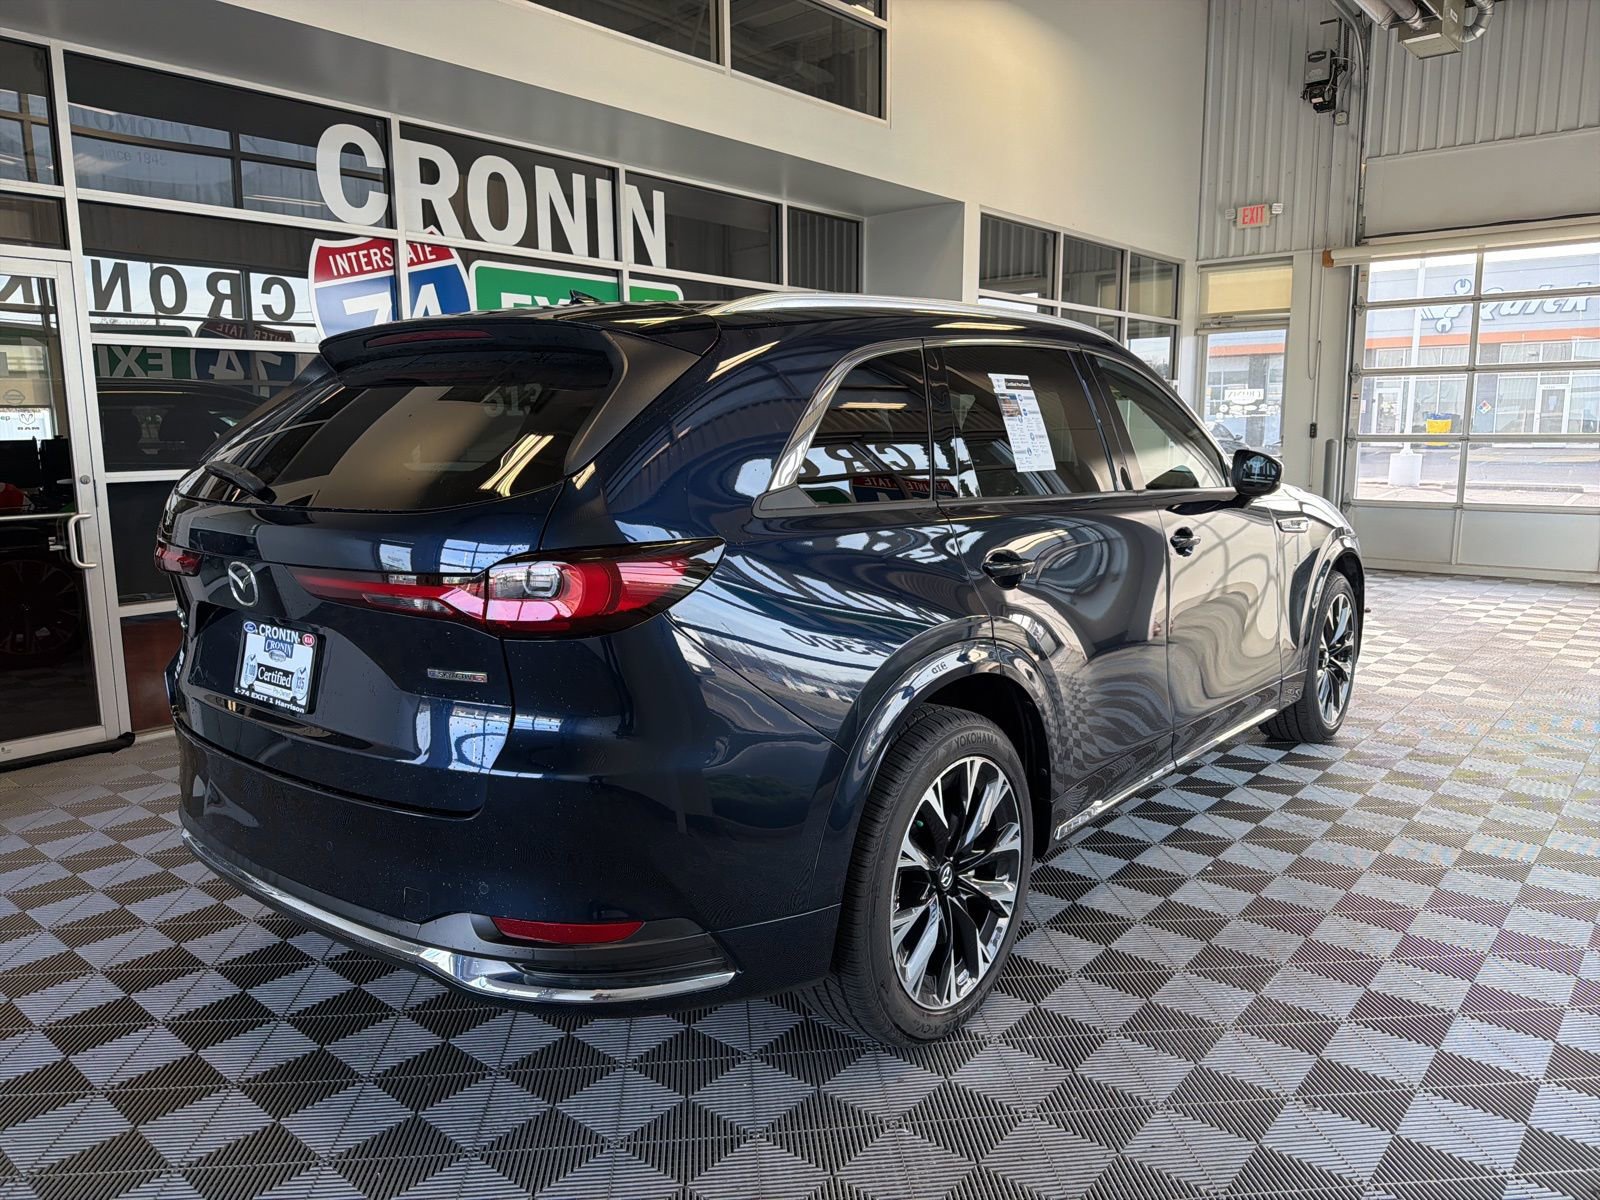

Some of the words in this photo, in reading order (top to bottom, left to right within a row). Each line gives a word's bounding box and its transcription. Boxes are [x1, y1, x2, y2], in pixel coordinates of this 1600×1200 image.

[316, 123, 667, 270] CRONIN
[1242, 204, 1265, 225] EXIT
[328, 239, 438, 277] INTERSATE
[259, 624, 298, 643] CRONIN
[266, 639, 293, 657] CRONIN
[258, 667, 292, 687] Certified
[251, 692, 268, 702] EXIT
[275, 699, 305, 713] Harrison
[954, 732, 998, 749] YOKOHAMA
